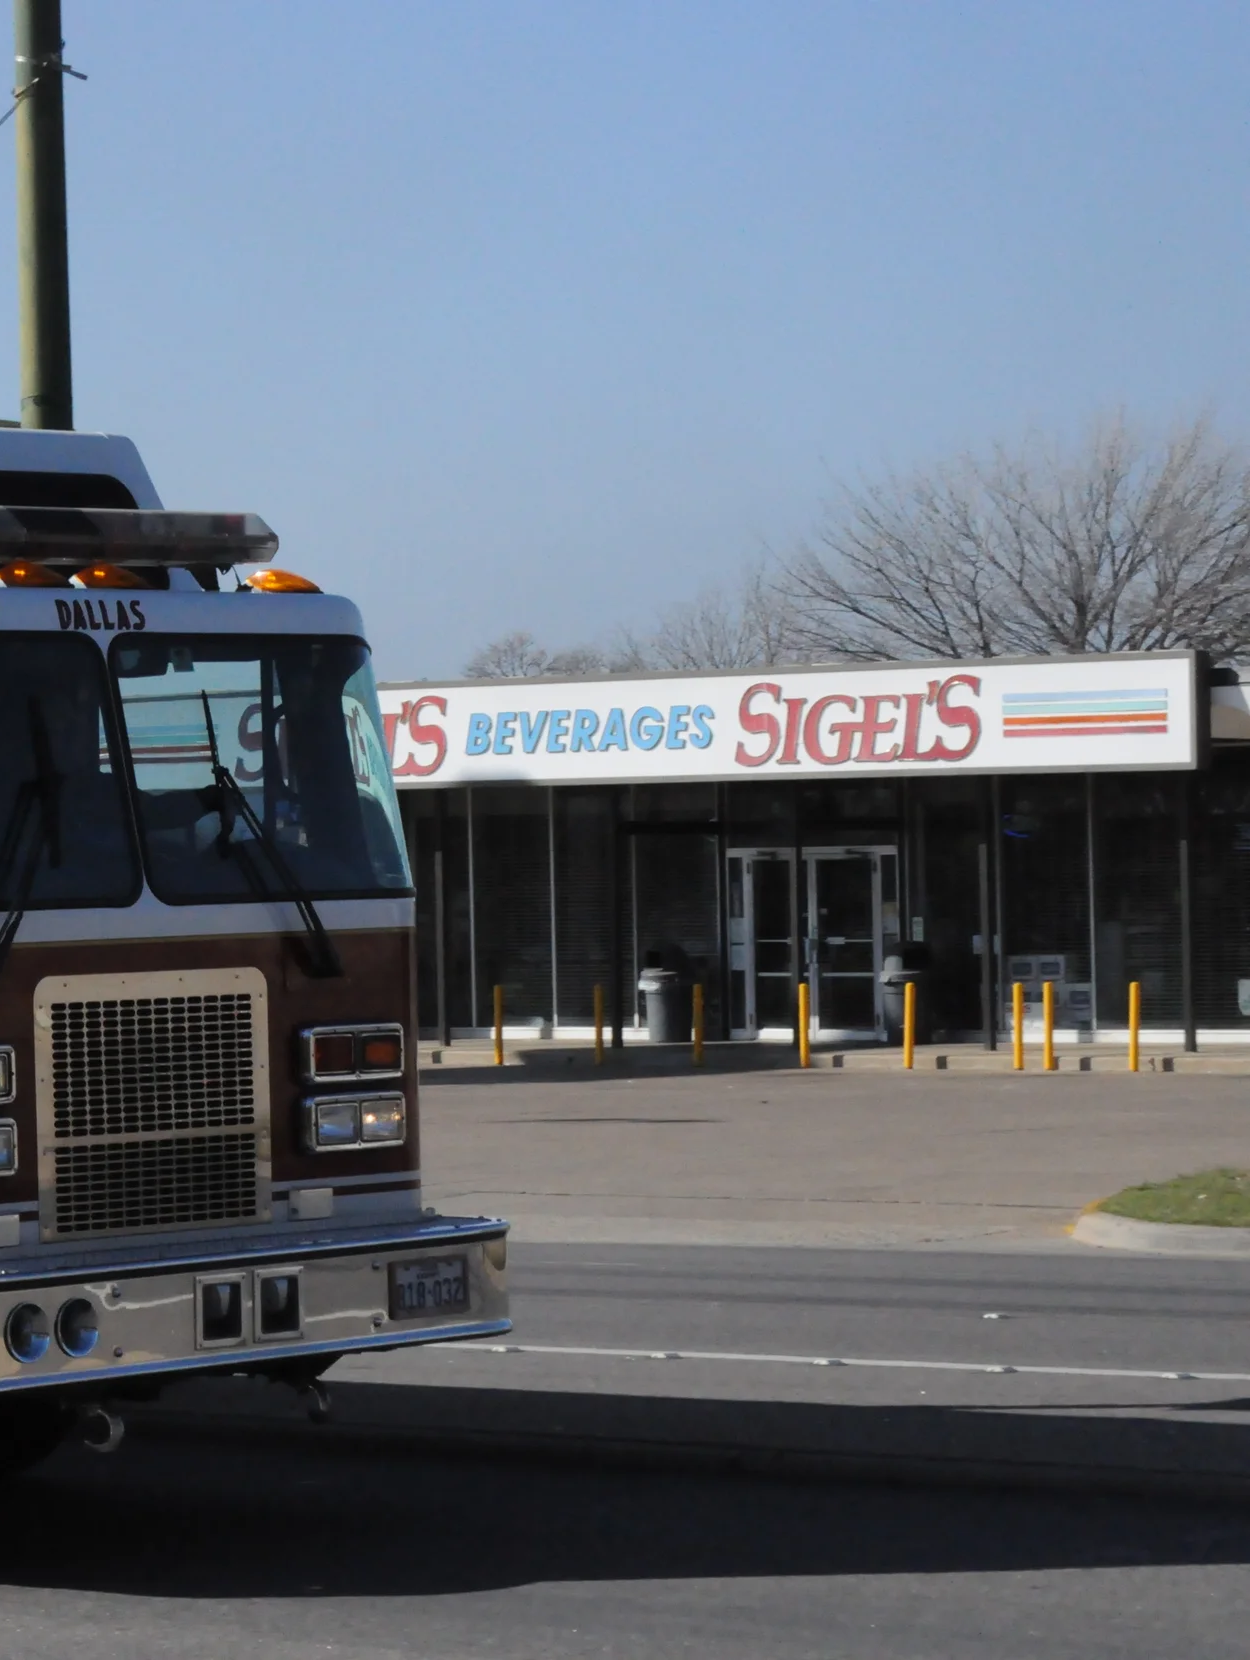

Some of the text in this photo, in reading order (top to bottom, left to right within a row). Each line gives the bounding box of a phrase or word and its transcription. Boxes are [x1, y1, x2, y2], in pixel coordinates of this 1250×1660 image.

[54, 599, 146, 631] DALLAS
[465, 704, 715, 756] BEVERAGES
[735, 674, 982, 767] SIGEL'S
